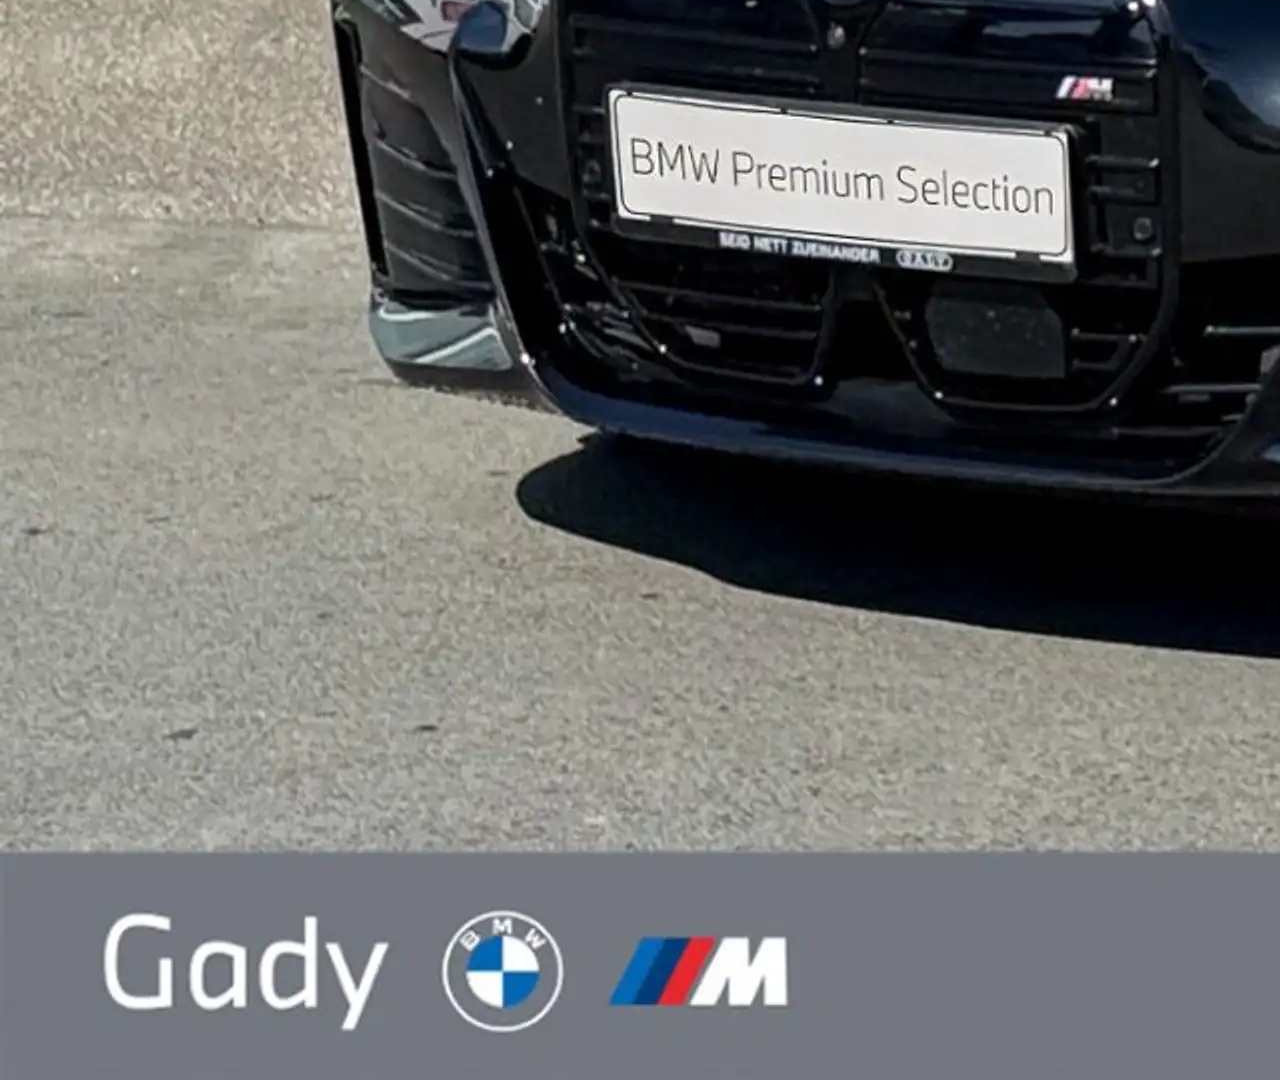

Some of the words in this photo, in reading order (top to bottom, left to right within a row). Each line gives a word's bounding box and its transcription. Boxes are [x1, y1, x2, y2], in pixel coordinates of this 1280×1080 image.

[630, 136, 720, 184] BMW
[731, 150, 885, 202] Premium
[896, 164, 1054, 216] Selection
